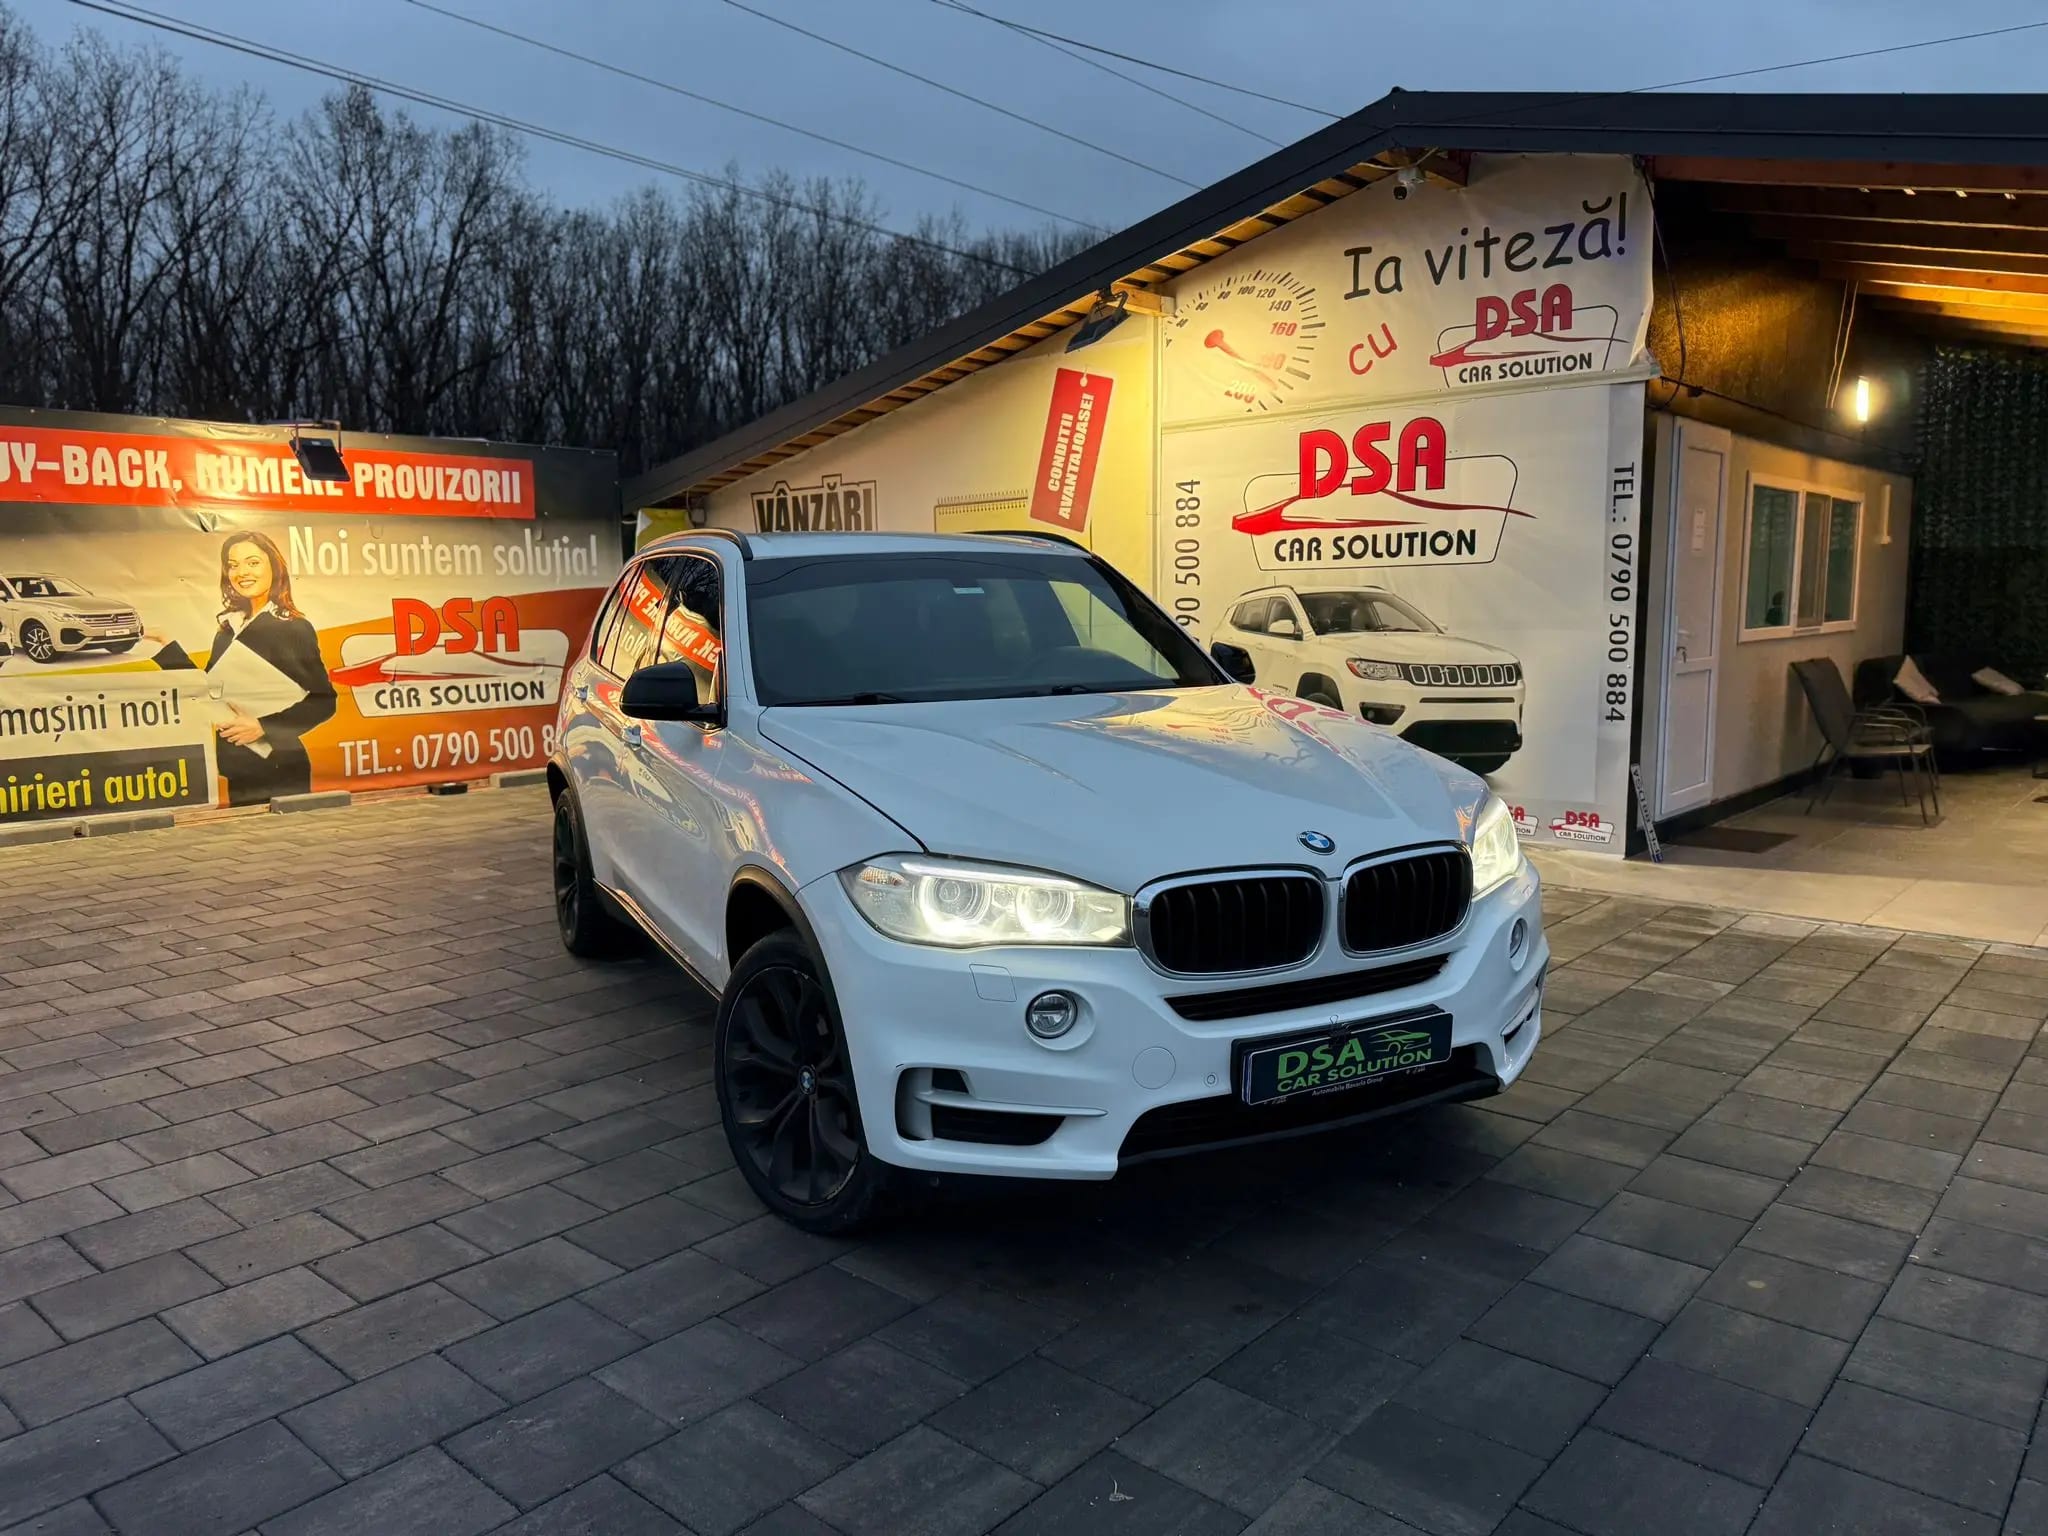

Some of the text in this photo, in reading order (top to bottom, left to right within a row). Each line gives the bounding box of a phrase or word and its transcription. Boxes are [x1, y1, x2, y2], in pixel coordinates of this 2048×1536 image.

[1344, 191, 1626, 300] Ia viteză!
[1256, 287, 1277, 299] 120
[1268, 300, 1293, 312] 140
[1475, 283, 1573, 342] DSA
[1270, 322, 1298, 337] 160
[1348, 322, 1398, 375] cu
[1459, 352, 1593, 384] CAR SOLUTION
[1299, 416, 1446, 499] DSA
[353, 462, 521, 504] PROVIZORII
[1175, 479, 1201, 528] 884
[288, 526, 349, 576] Noi
[361, 535, 483, 576] suntem
[1174, 539, 1201, 586] 500
[1274, 529, 1477, 562] CAR SOLUTION
[1611, 533, 1632, 602] 0790
[392, 596, 520, 656] DSA
[1608, 613, 1630, 663] 500
[121, 688, 181, 727] noi!
[374, 680, 545, 709] CAR SOLUTION
[1605, 673, 1627, 723] 884
[412, 730, 480, 770] 0790
[489, 725, 535, 762] 500
[104, 759, 189, 805] auto!
[1565, 810, 1600, 829] DSA
[1573, 831, 1606, 842] SOLUTION
[1276, 1048, 1433, 1092] CAR SOLUTION
[1277, 1037, 1366, 1080] DSA
